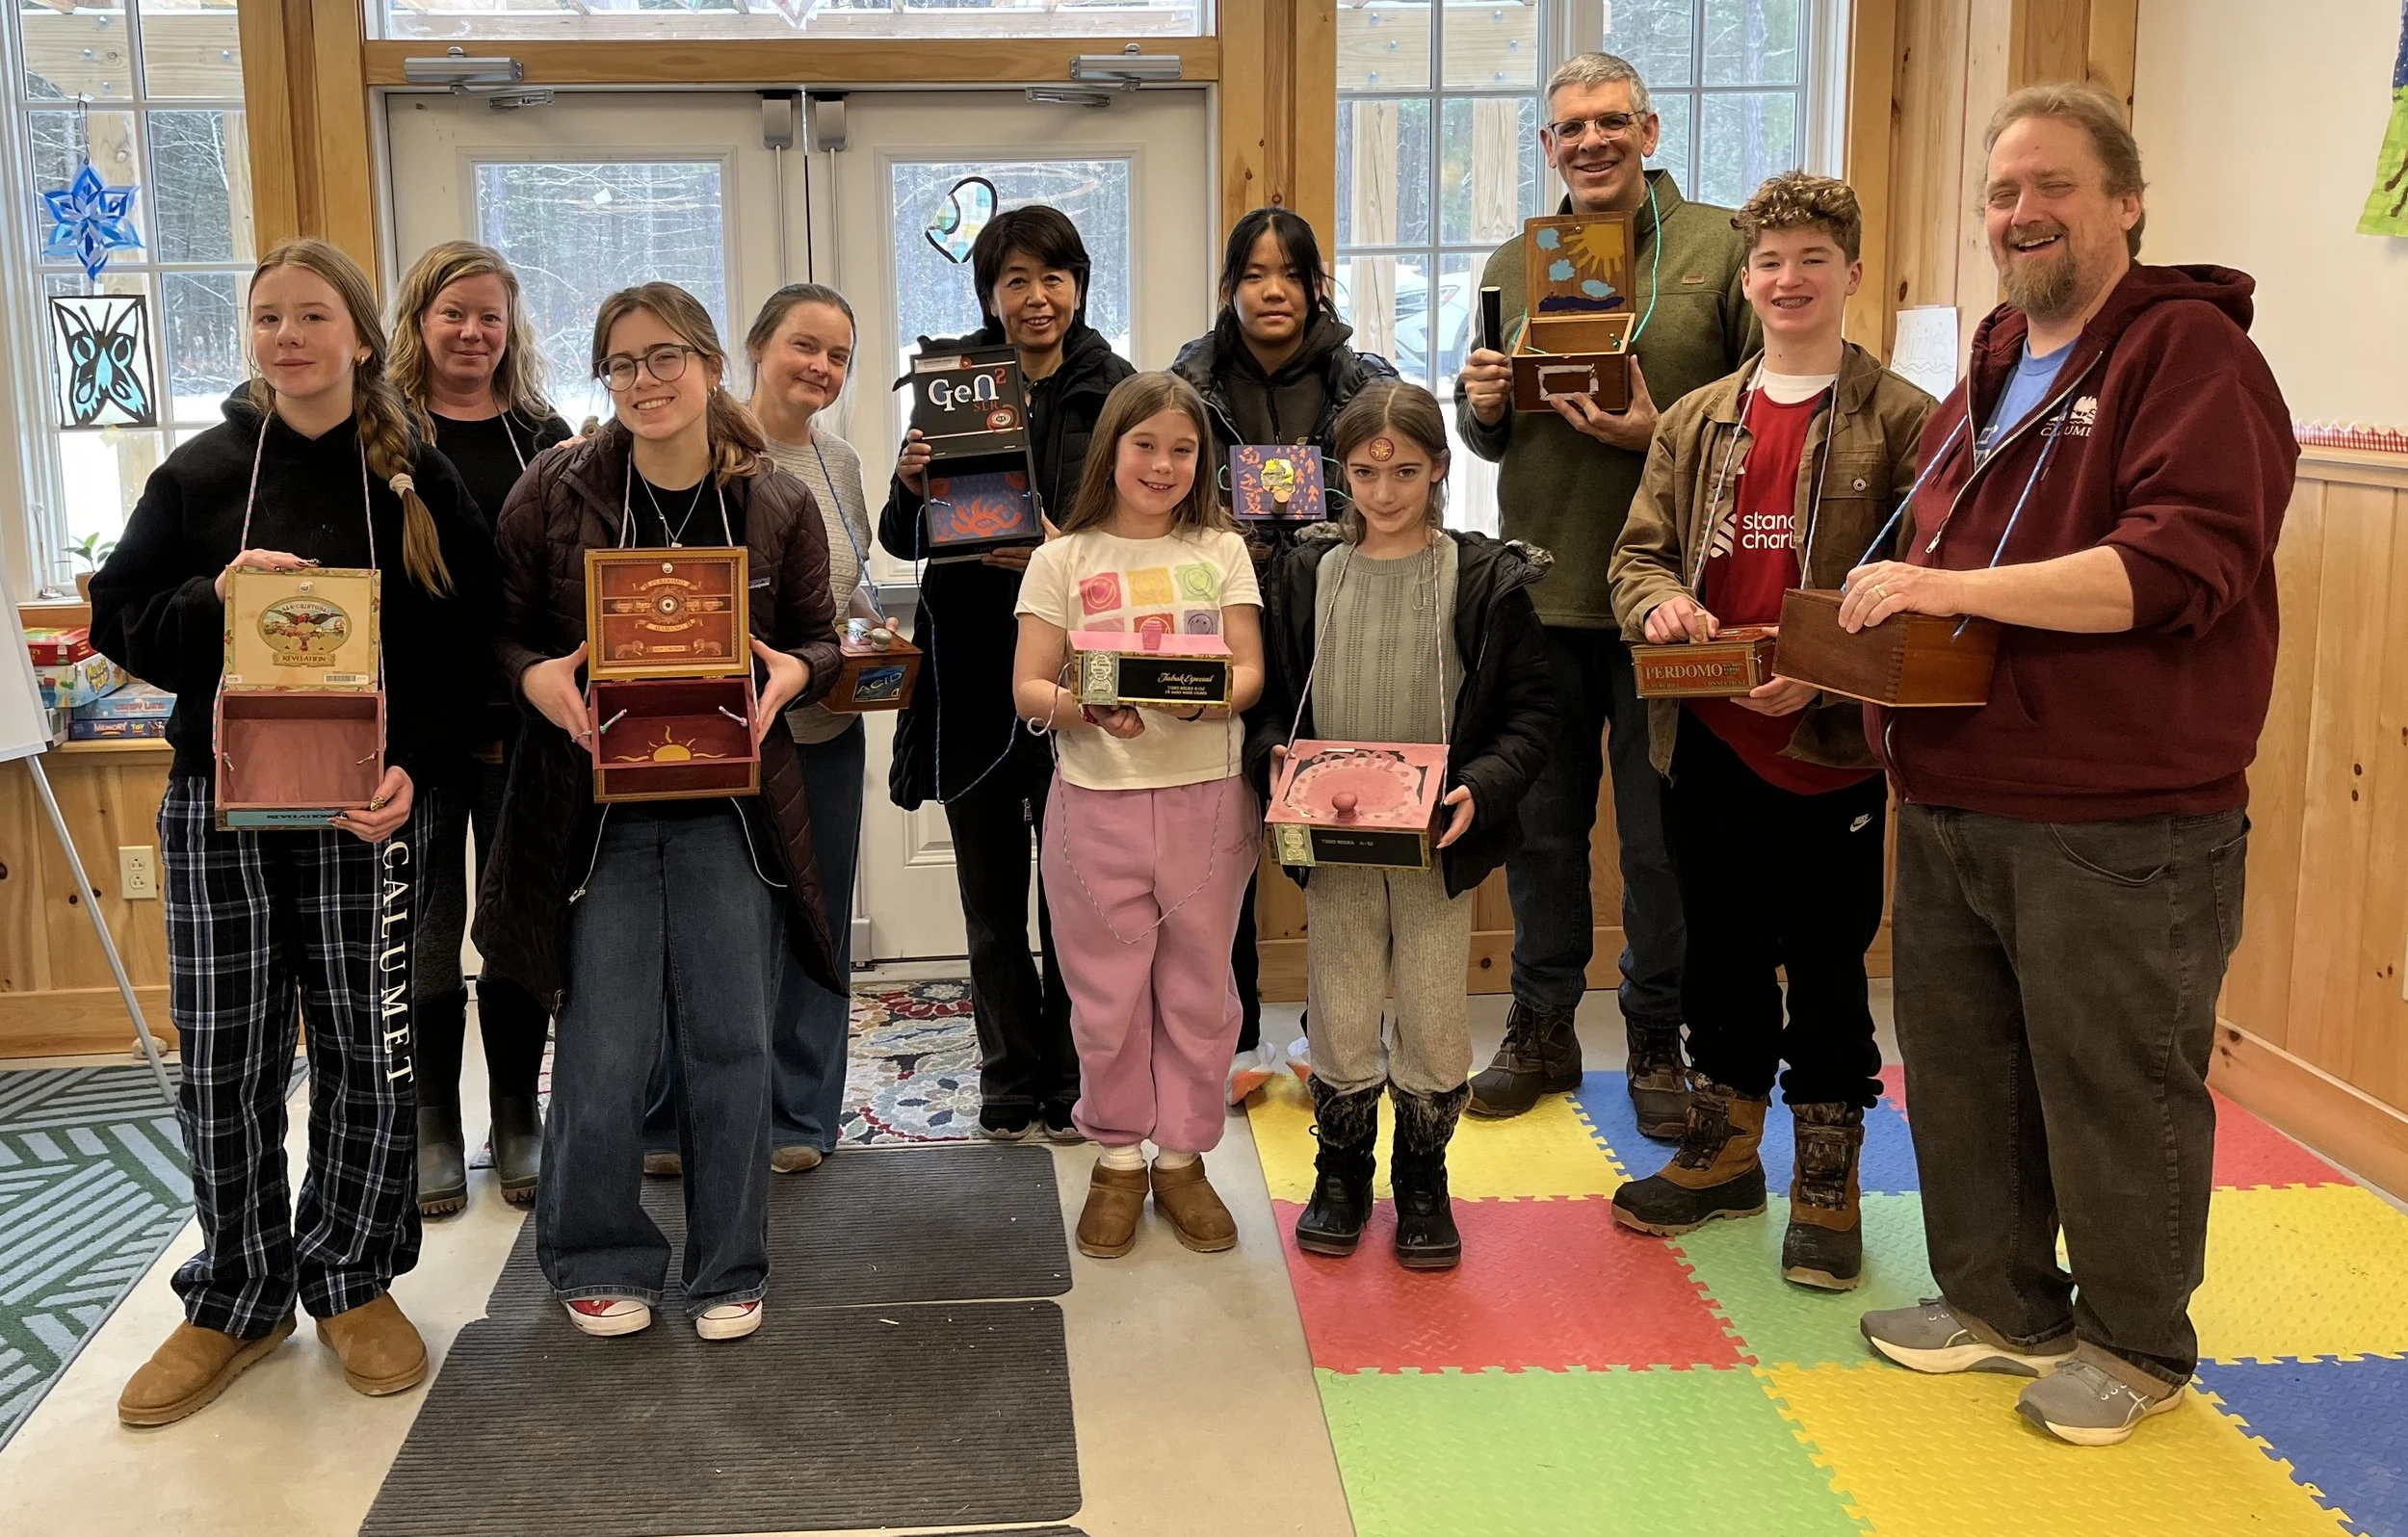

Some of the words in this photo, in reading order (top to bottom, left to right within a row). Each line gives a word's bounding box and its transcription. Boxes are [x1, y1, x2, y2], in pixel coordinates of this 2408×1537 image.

[1645, 664, 1723, 680] PERDOMO
[856, 672, 903, 695] ACID
[93, 721, 128, 732] MEMORY
[380, 841, 414, 1083] CALUMET
